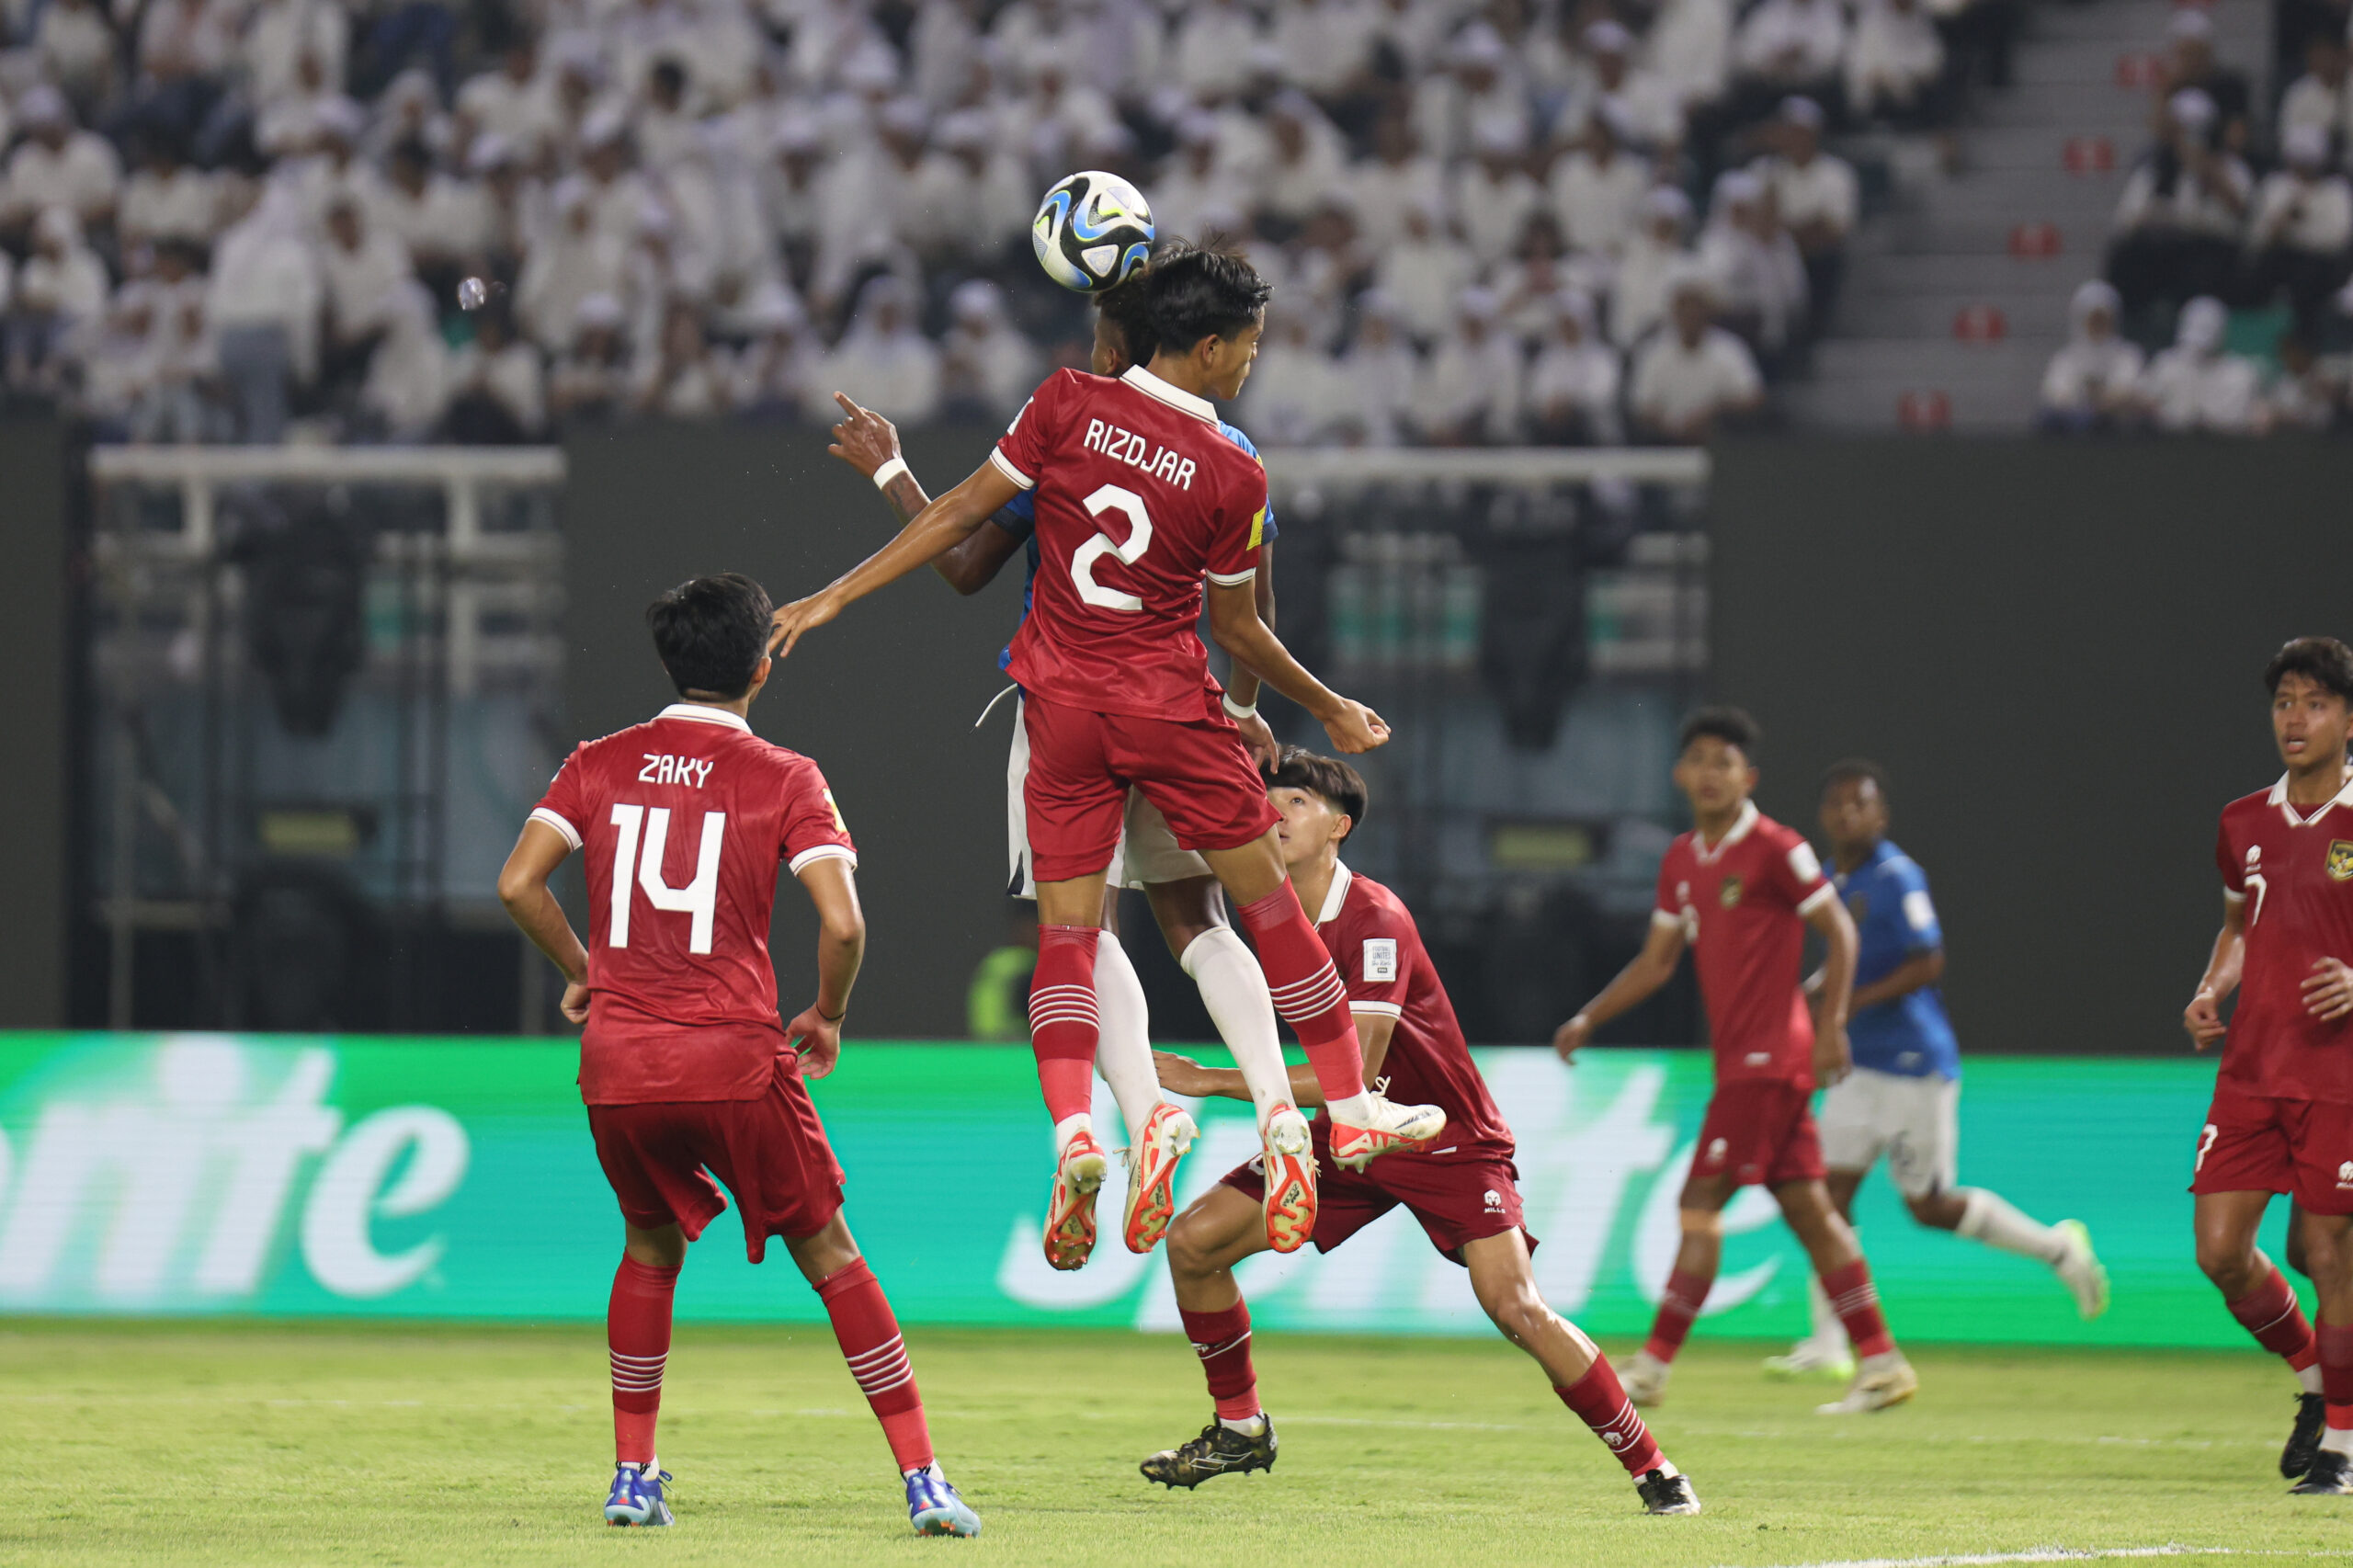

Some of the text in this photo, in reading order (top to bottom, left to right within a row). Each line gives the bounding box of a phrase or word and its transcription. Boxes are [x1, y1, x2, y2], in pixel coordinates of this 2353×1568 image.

[1083, 417, 1196, 491] RIZDJAR
[1070, 483, 1154, 611] 2
[638, 753, 714, 790] ZAKY
[608, 802, 726, 955] 14
[2244, 873, 2268, 928] 7
[0, 1034, 472, 1300] rite
[2195, 1123, 2219, 1173] 7
